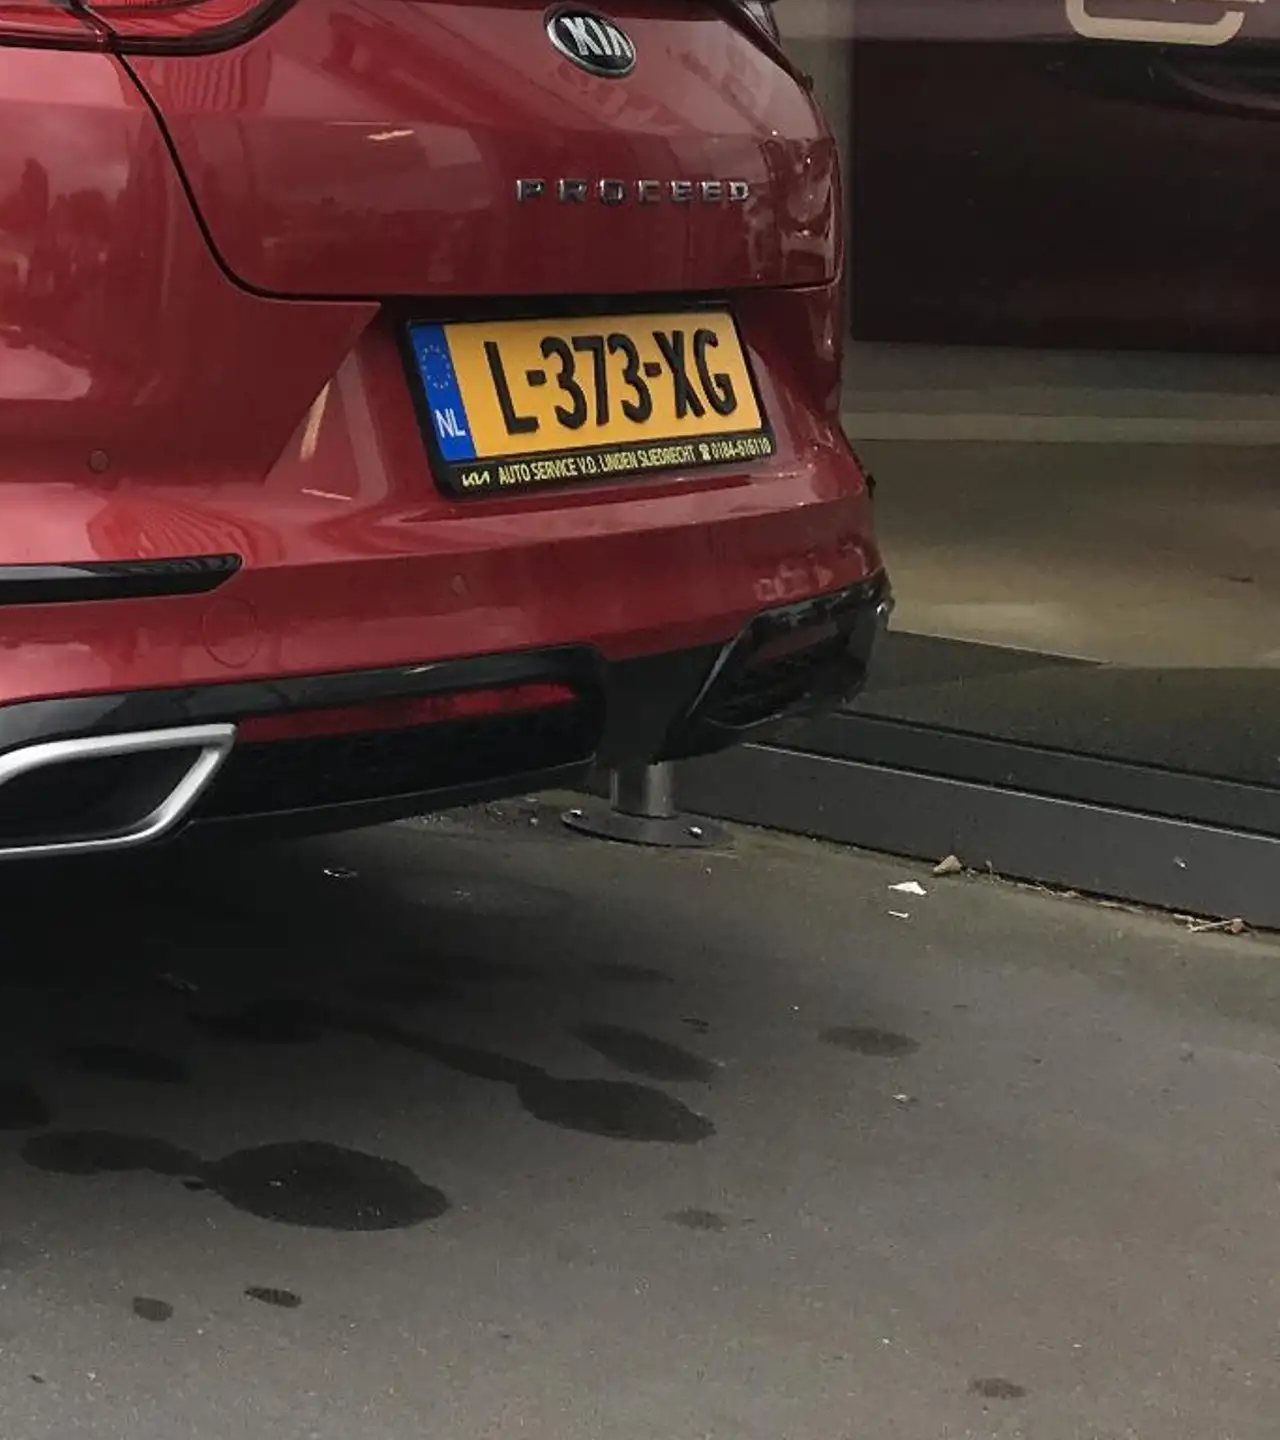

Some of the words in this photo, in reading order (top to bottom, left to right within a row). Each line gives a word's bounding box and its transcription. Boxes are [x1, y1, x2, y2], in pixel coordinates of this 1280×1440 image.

[559, 16, 632, 58] KIA
[515, 177, 750, 205] PROCEED
[483, 327, 739, 436] L-373-XG
[435, 406, 466, 439] NL
[498, 462, 531, 485] AUTO
[531, 457, 578, 480] SERVICE
[599, 450, 638, 472] LINDEN
[637, 443, 696, 467] SLIEDRECHT
